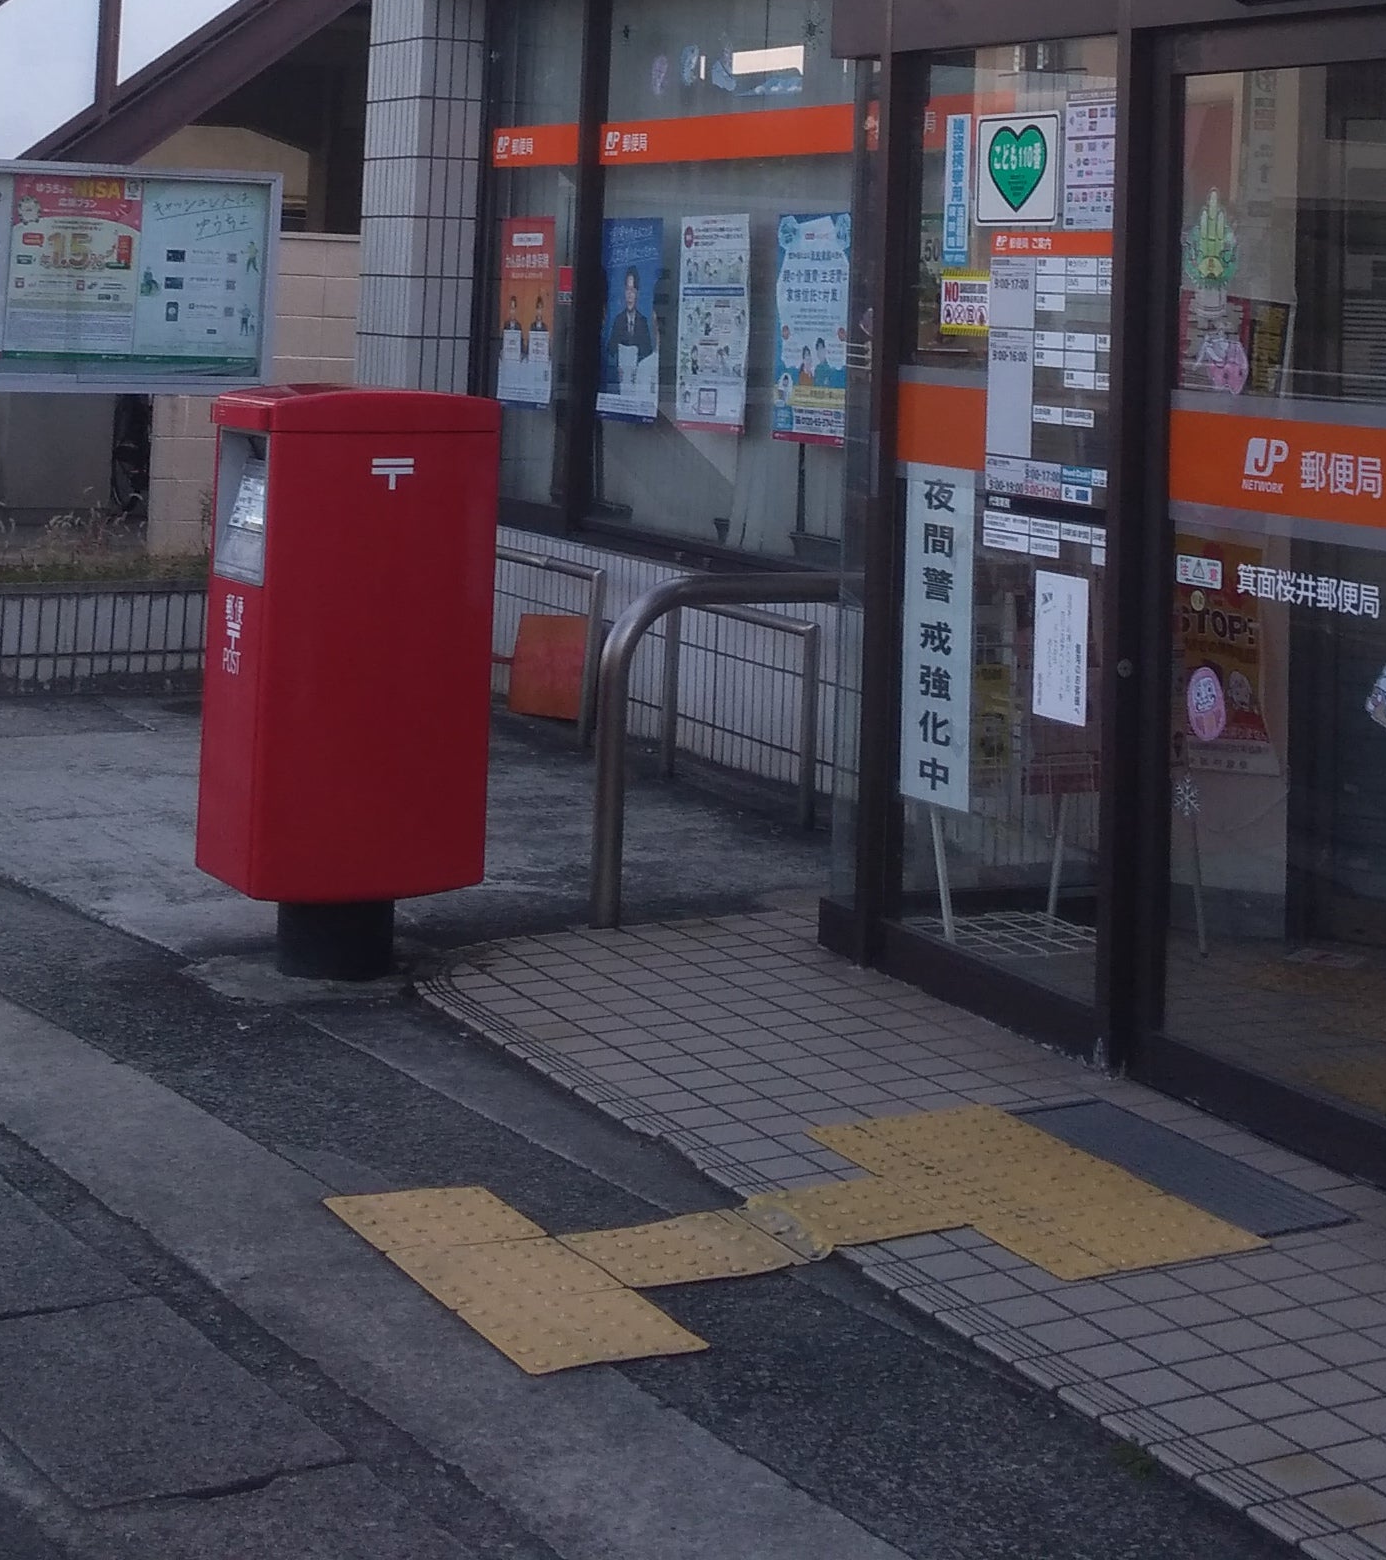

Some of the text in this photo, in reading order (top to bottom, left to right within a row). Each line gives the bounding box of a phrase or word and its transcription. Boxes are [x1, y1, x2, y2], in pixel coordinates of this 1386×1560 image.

[944, 281, 960, 303] NO
[1241, 478, 1284, 495] NETWORK
[1300, 450, 1383, 500] 郵便局
[1236, 562, 1381, 620] 箕面桜井郵便局
[918, 479, 957, 792] 夜間警戒強化中
[222, 647, 242, 676] POST
